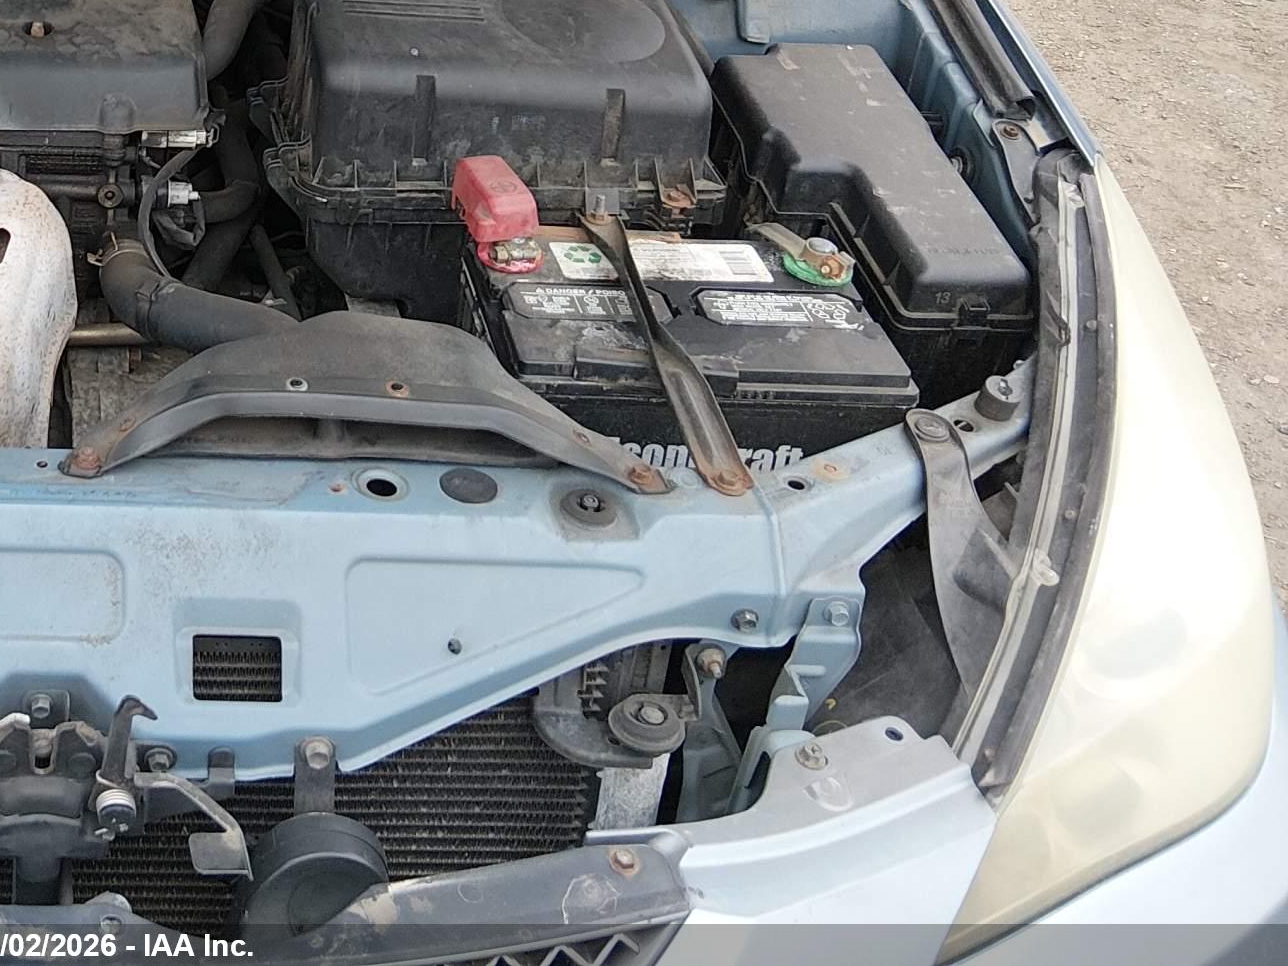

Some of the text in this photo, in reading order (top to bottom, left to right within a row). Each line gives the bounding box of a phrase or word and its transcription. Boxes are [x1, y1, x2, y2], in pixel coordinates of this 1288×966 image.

[545, 287, 586, 295] DANGER
[595, 289, 625, 297] POISO
[935, 291, 952, 304] 13
